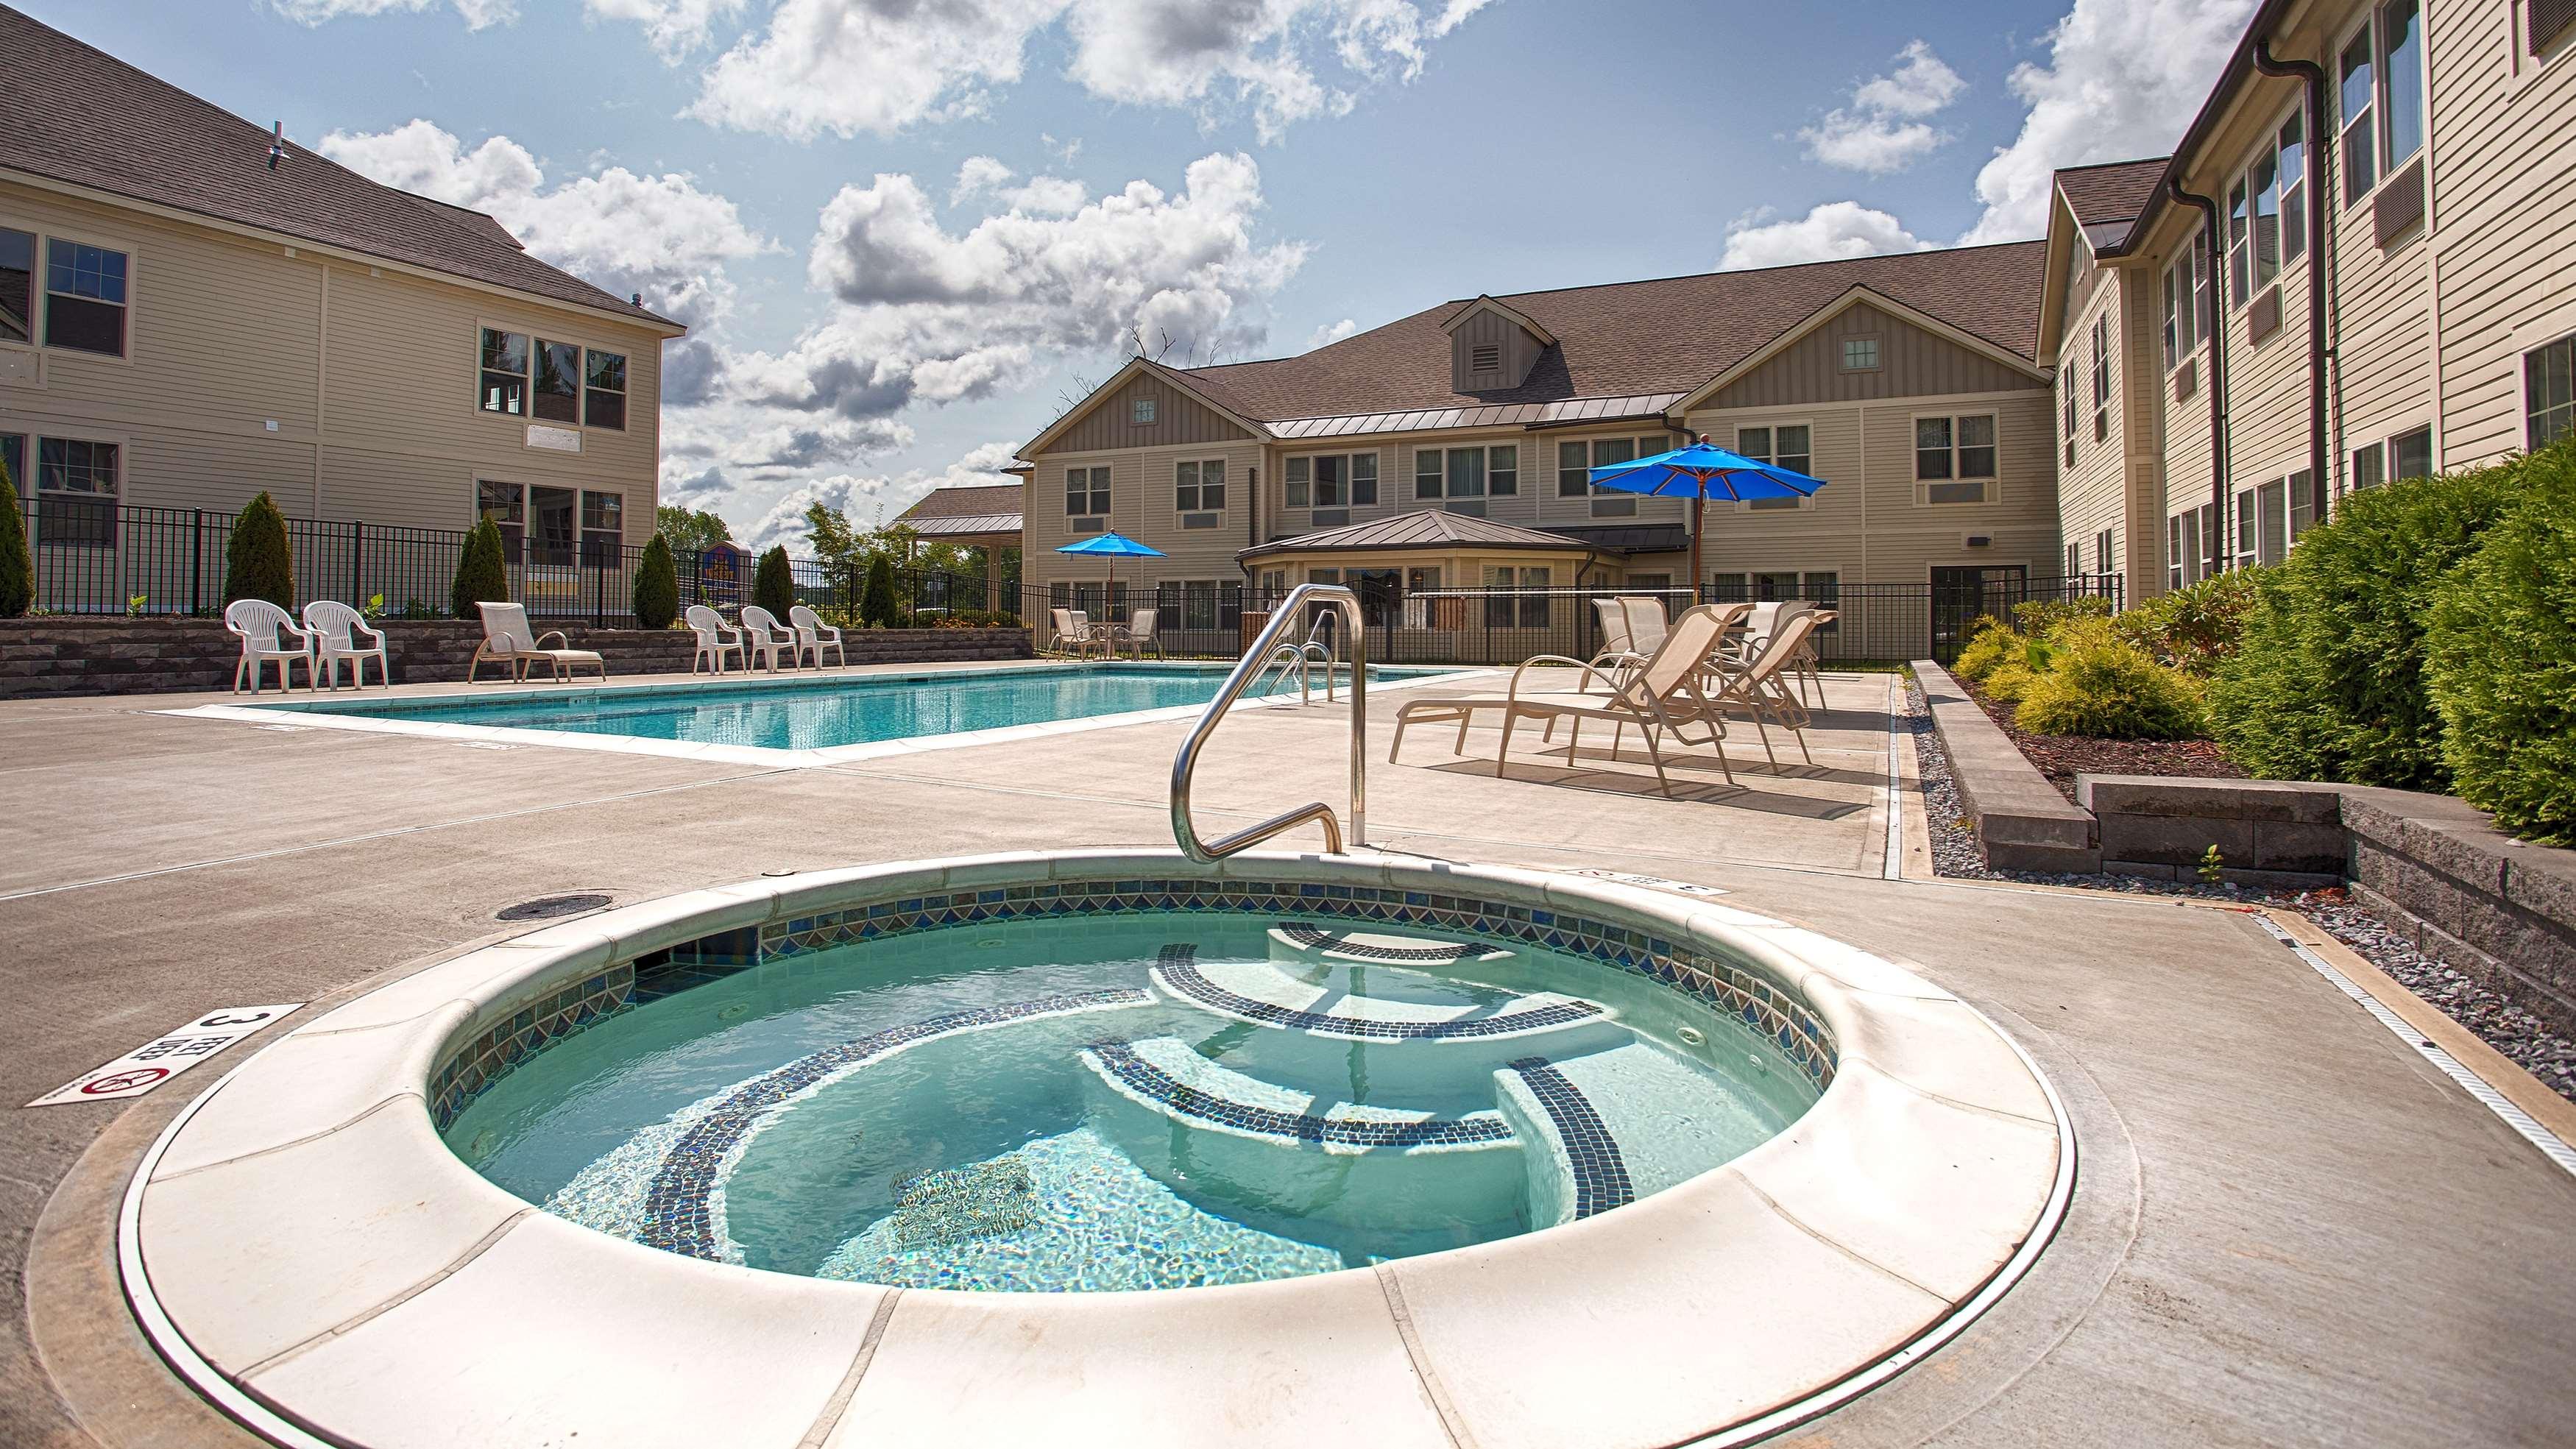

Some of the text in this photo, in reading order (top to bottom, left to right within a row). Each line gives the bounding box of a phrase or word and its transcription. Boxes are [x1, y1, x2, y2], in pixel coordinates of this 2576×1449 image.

[199, 1013, 271, 1027] 3
[129, 1038, 194, 1061] DEEP
[171, 1035, 235, 1057] FEET
